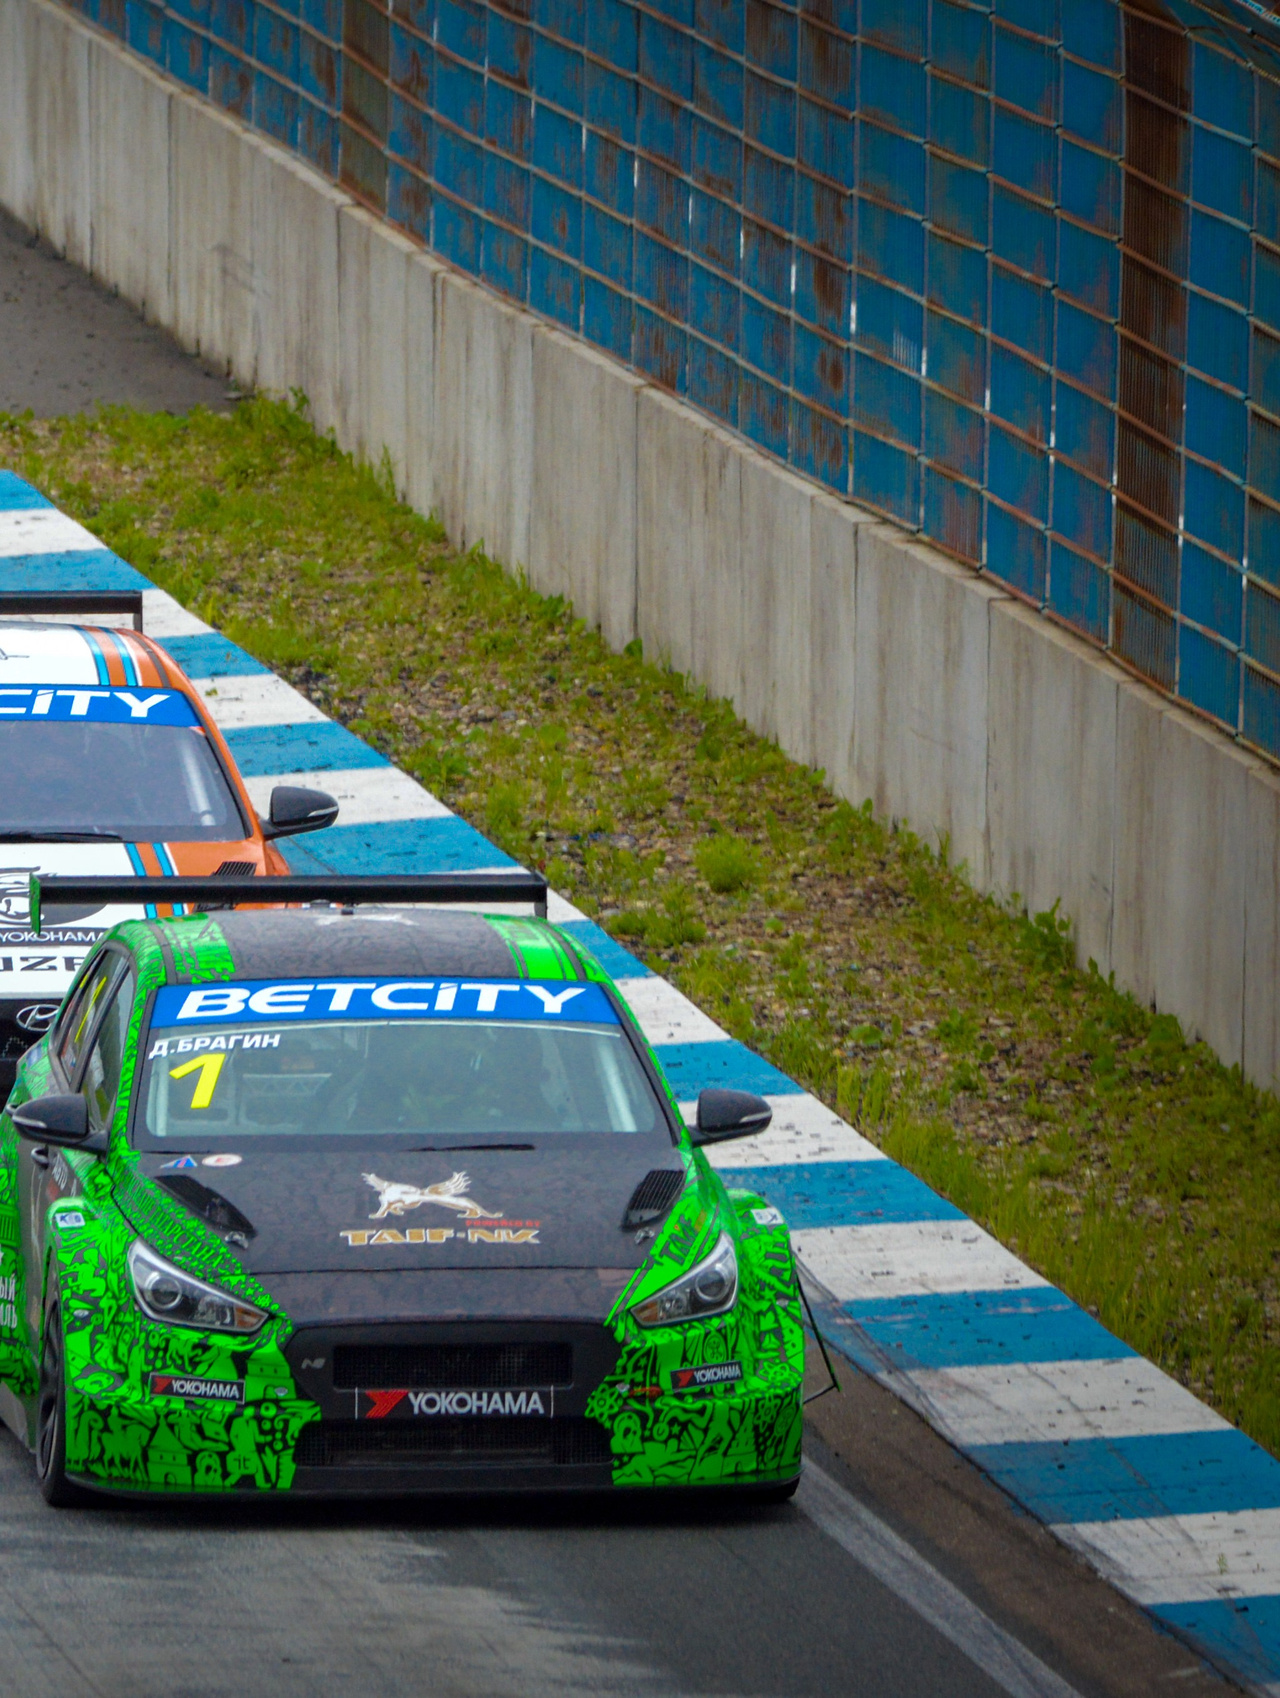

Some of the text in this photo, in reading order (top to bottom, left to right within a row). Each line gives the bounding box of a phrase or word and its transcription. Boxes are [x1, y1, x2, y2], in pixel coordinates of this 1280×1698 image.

[148, 1033, 280, 1060] Д.БРАГИН
[168, 1053, 226, 1109] 1
[340, 1228, 541, 1246] TAIF-NK
[693, 1365, 742, 1383] YOKOHAMA
[171, 1380, 239, 1399] YOKOHAMA
[408, 1391, 545, 1414] YOKOHAMA
